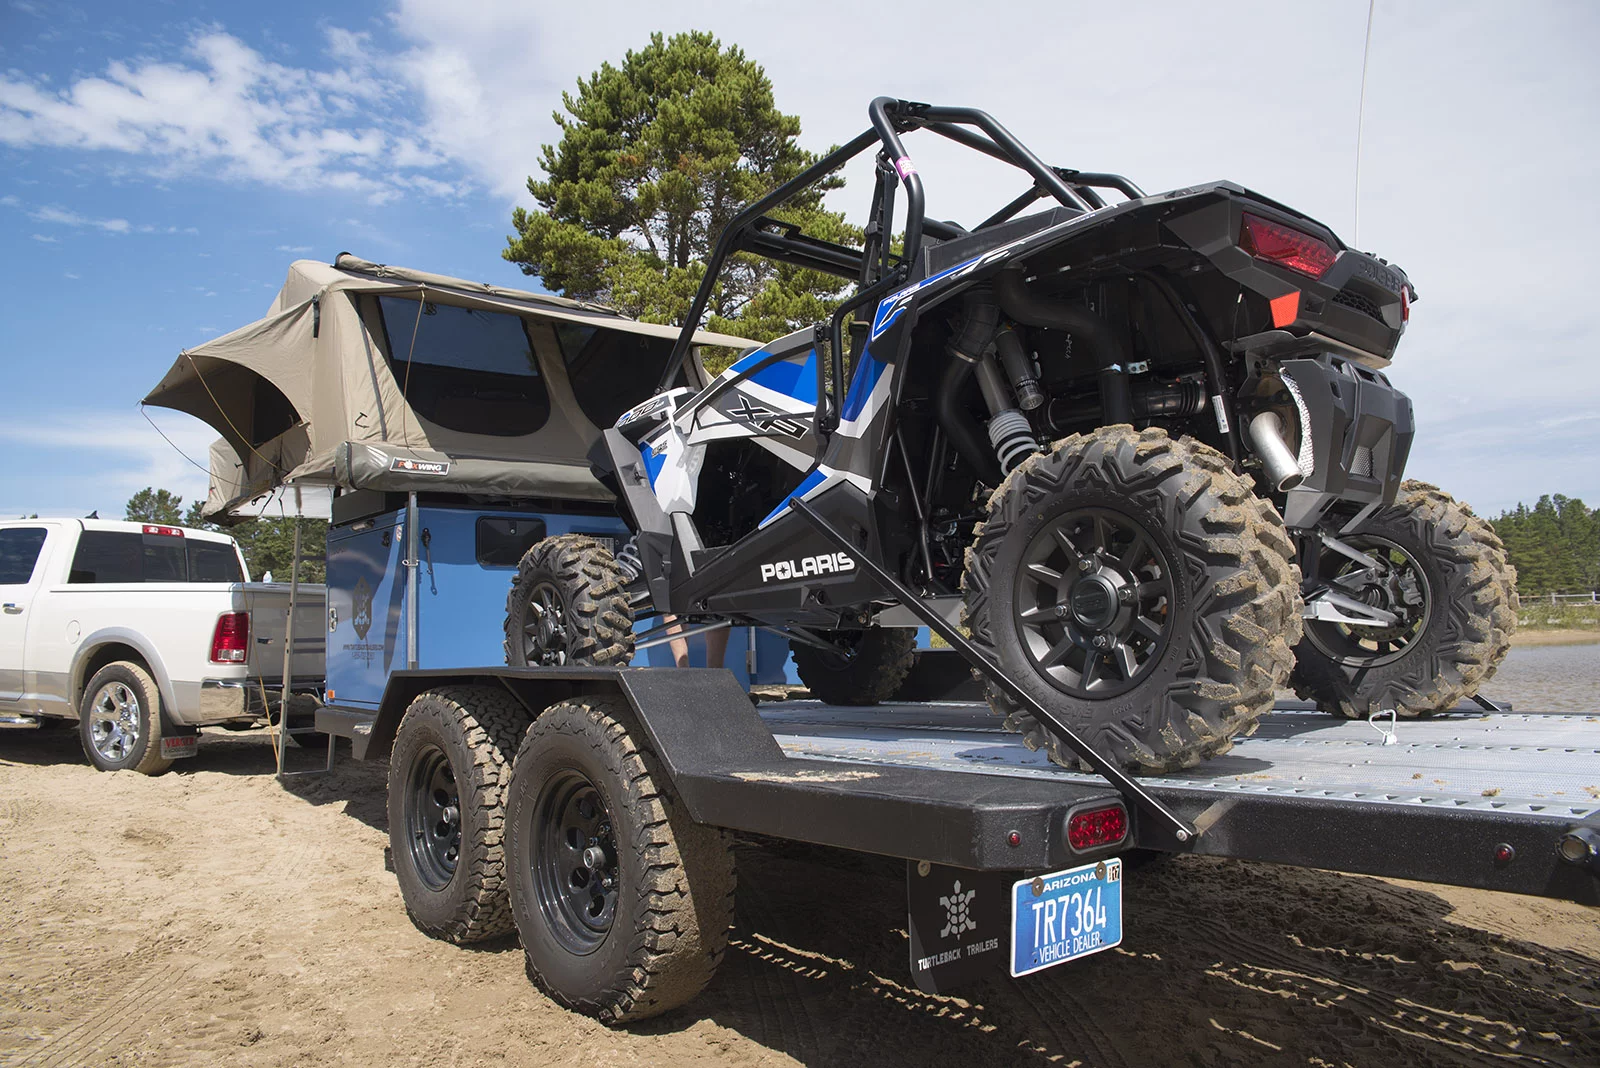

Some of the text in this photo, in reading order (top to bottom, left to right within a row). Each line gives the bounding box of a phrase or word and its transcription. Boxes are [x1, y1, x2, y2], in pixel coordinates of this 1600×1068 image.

[760, 551, 855, 582] POLARIS
[1042, 872, 1097, 893] ARIZONA
[1031, 886, 1107, 948] TR7364
[917, 938, 999, 971] TURTLEBACK TRAILERS
[1039, 931, 1101, 964] VEHICLE DEALER
